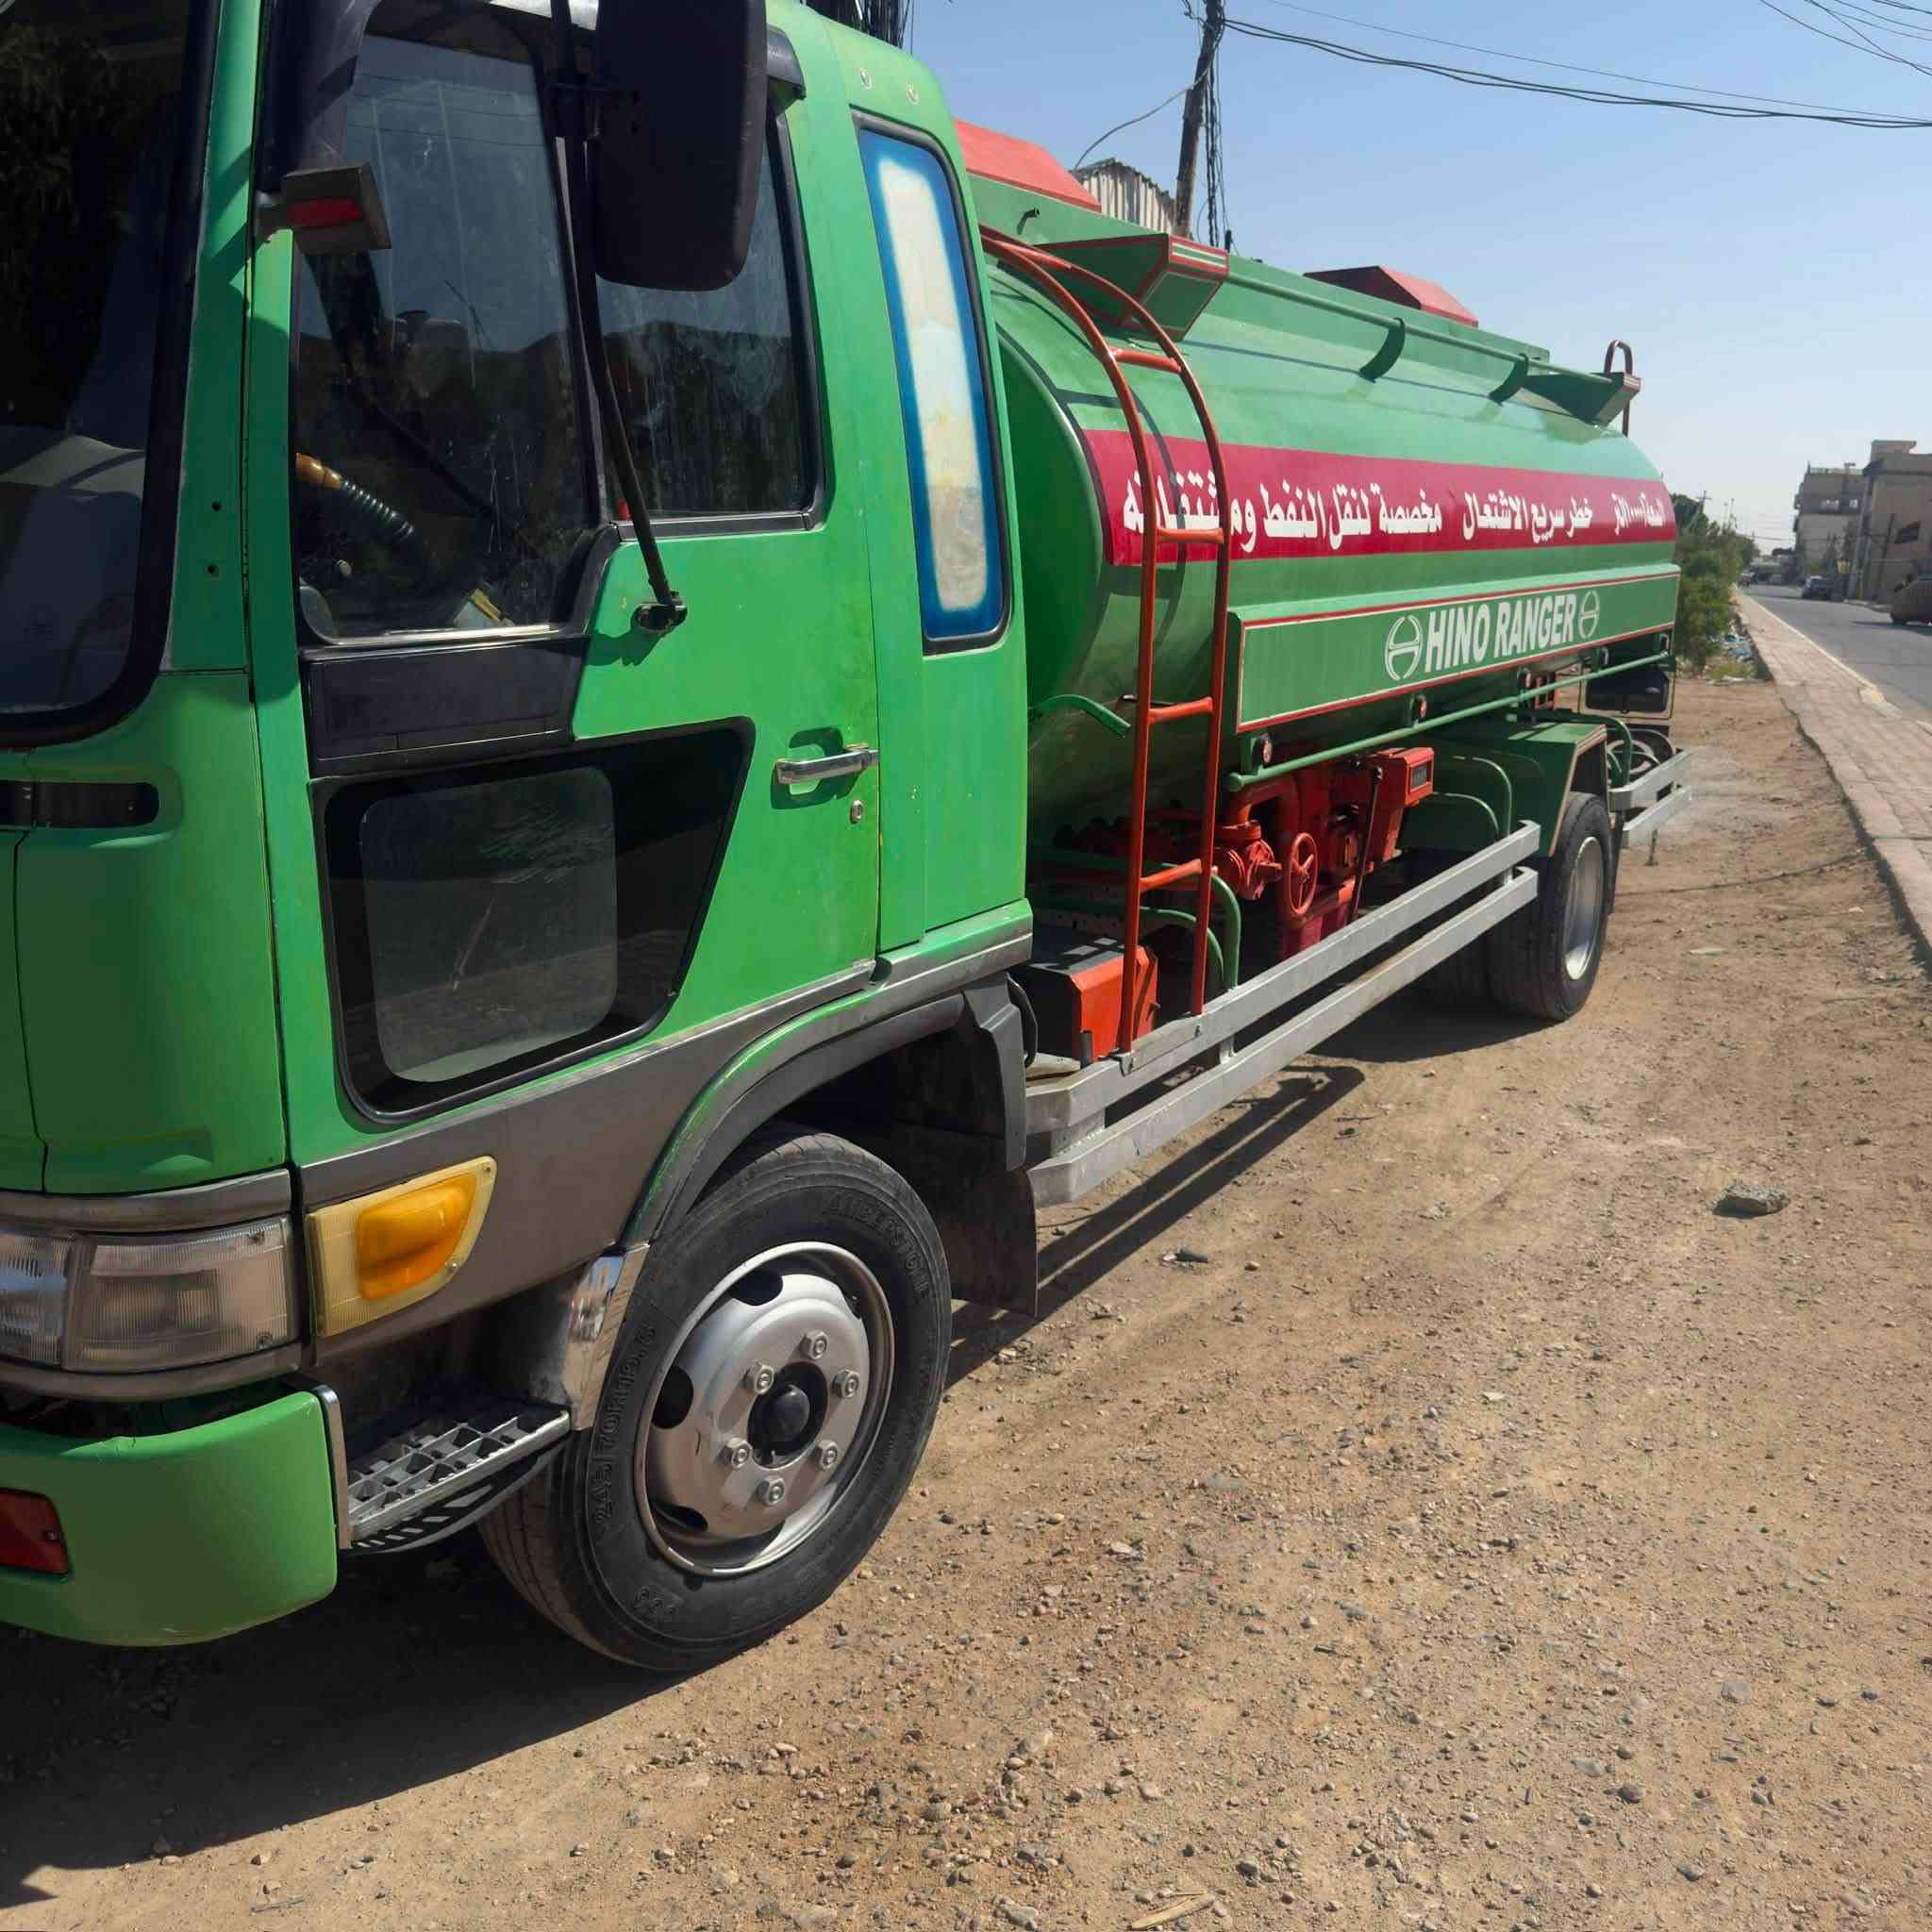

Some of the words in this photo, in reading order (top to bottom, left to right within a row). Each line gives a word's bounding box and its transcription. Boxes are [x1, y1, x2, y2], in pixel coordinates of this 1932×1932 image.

[1259, 479, 1326, 540] النفط
[1329, 483, 1371, 550] لنقل
[1370, 482, 1442, 534] مخصصة
[1463, 489, 1528, 541] الاشتعال
[1531, 502, 1565, 543] سريع
[1567, 496, 1593, 538] خطر
[1424, 603, 1491, 673] HINO
[1493, 593, 1577, 658] RANGER
